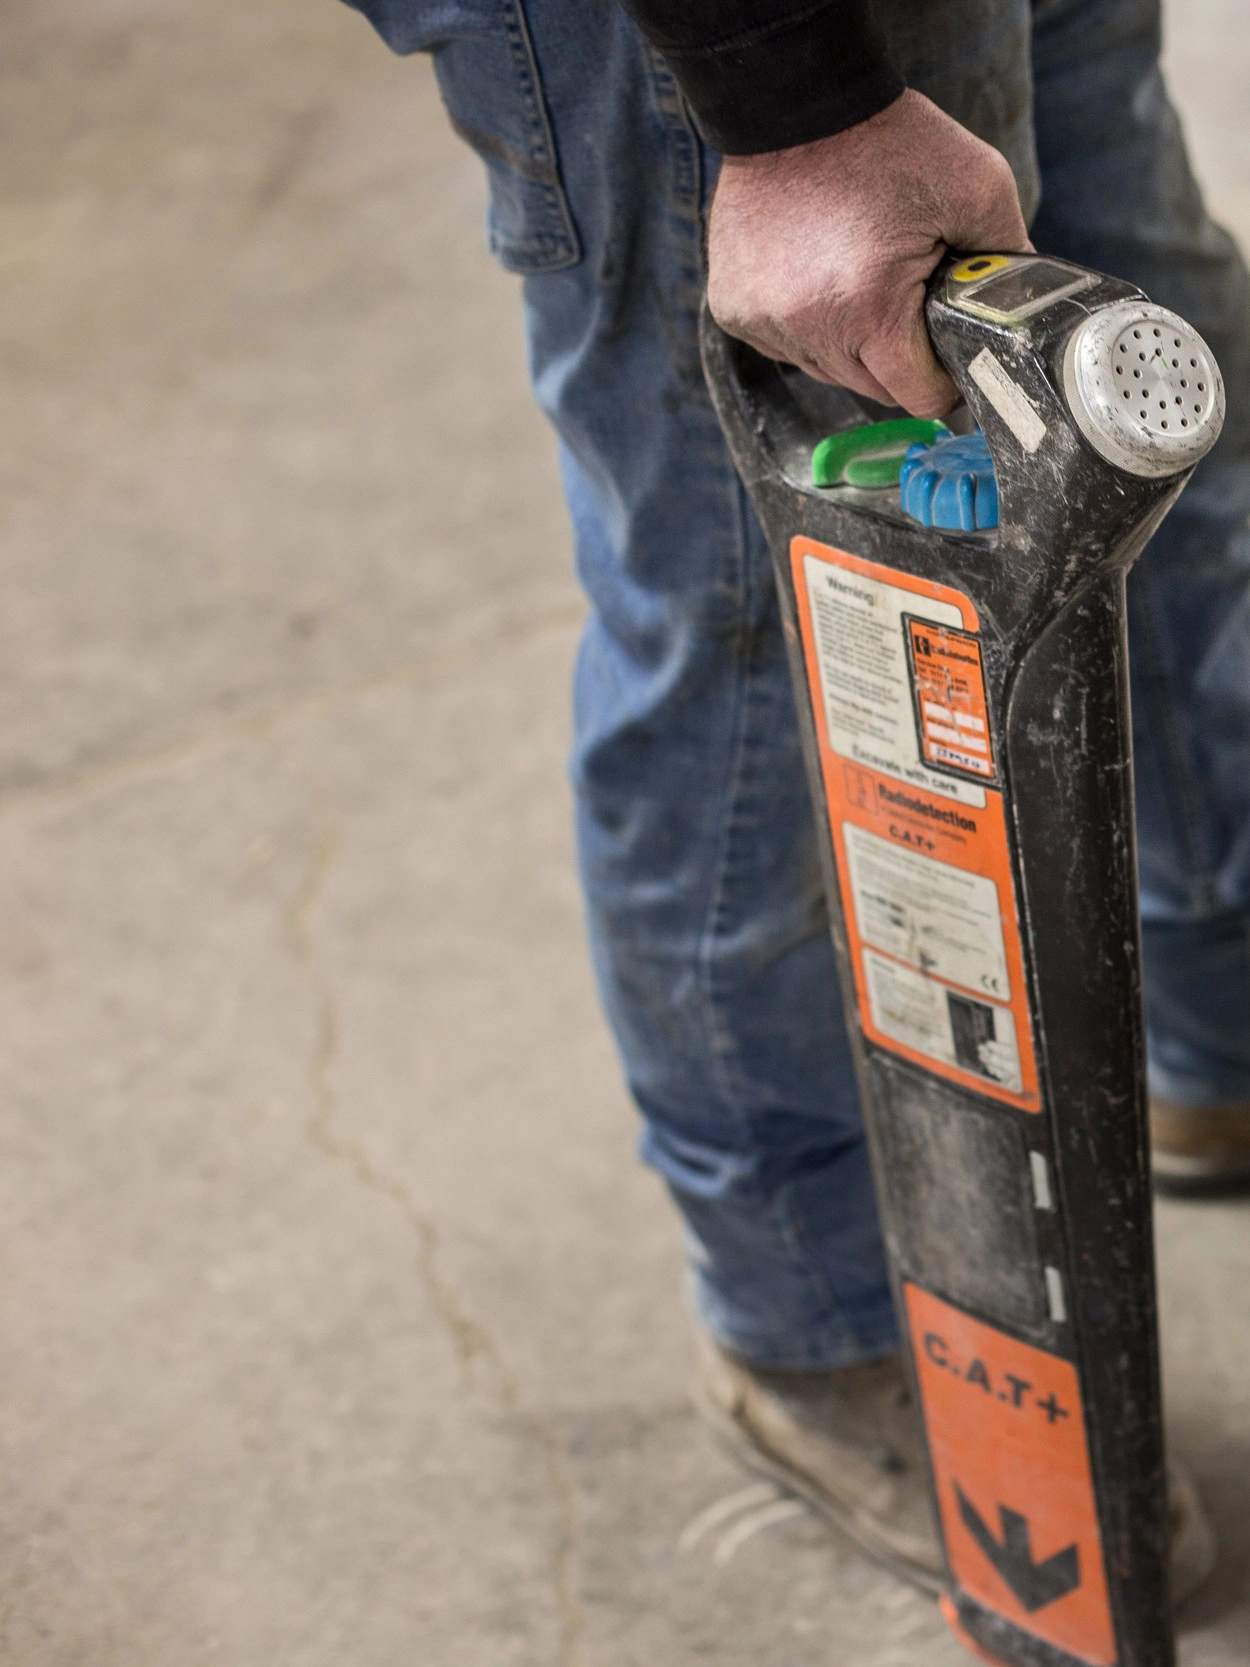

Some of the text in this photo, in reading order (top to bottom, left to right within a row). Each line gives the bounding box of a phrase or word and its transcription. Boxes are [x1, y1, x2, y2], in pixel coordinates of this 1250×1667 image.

[826, 575, 875, 607] Warning
[852, 743, 959, 796] Excavate with care
[878, 783, 977, 833] Radiodetection
[923, 1332, 1070, 1425] C.A.T+
